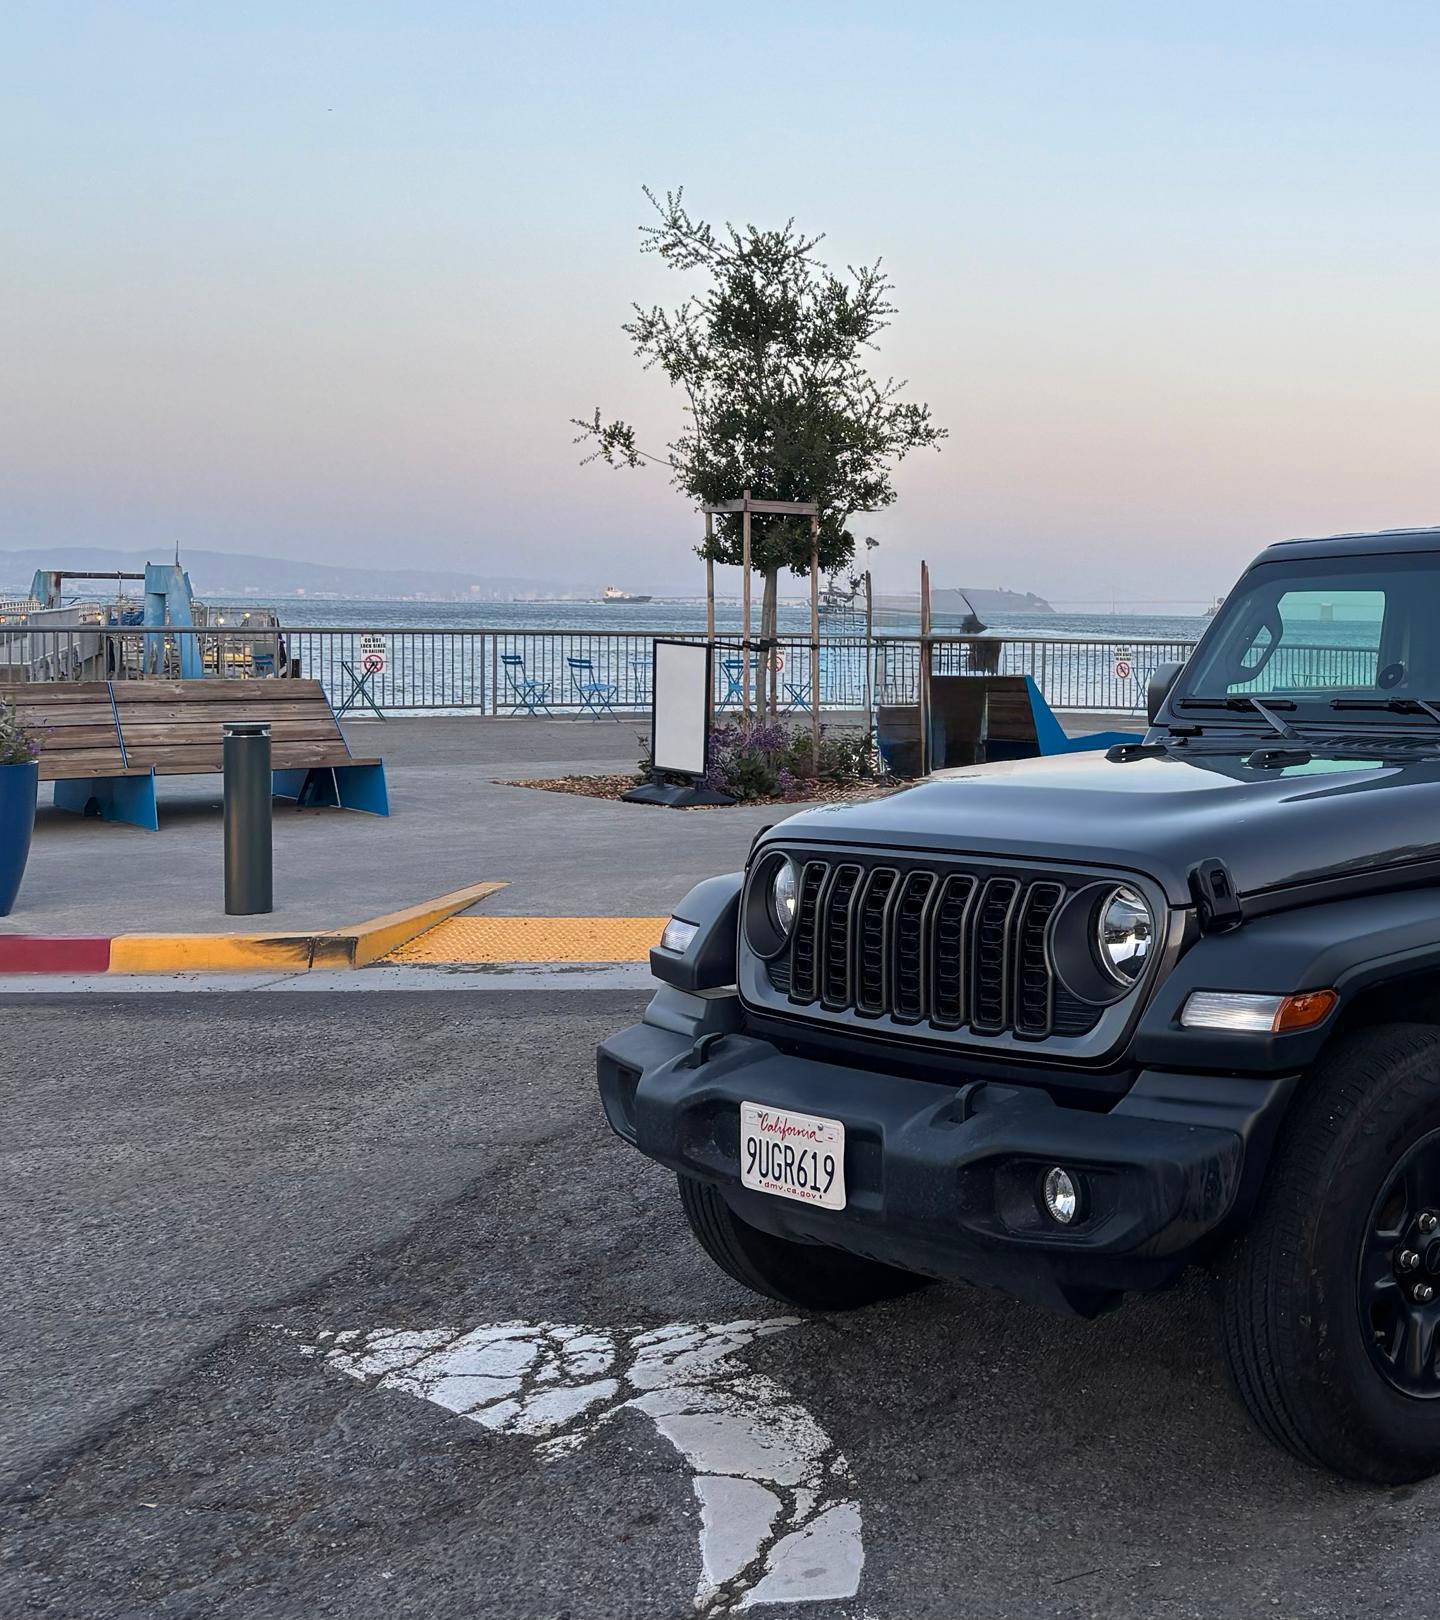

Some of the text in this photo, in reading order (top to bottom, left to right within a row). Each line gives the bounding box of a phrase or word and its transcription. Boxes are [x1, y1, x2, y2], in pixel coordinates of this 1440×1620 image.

[760, 1113, 823, 1142] California
[746, 1136, 835, 1194] 9UGR619
[764, 1182, 817, 1199] dmv.ca.gov
